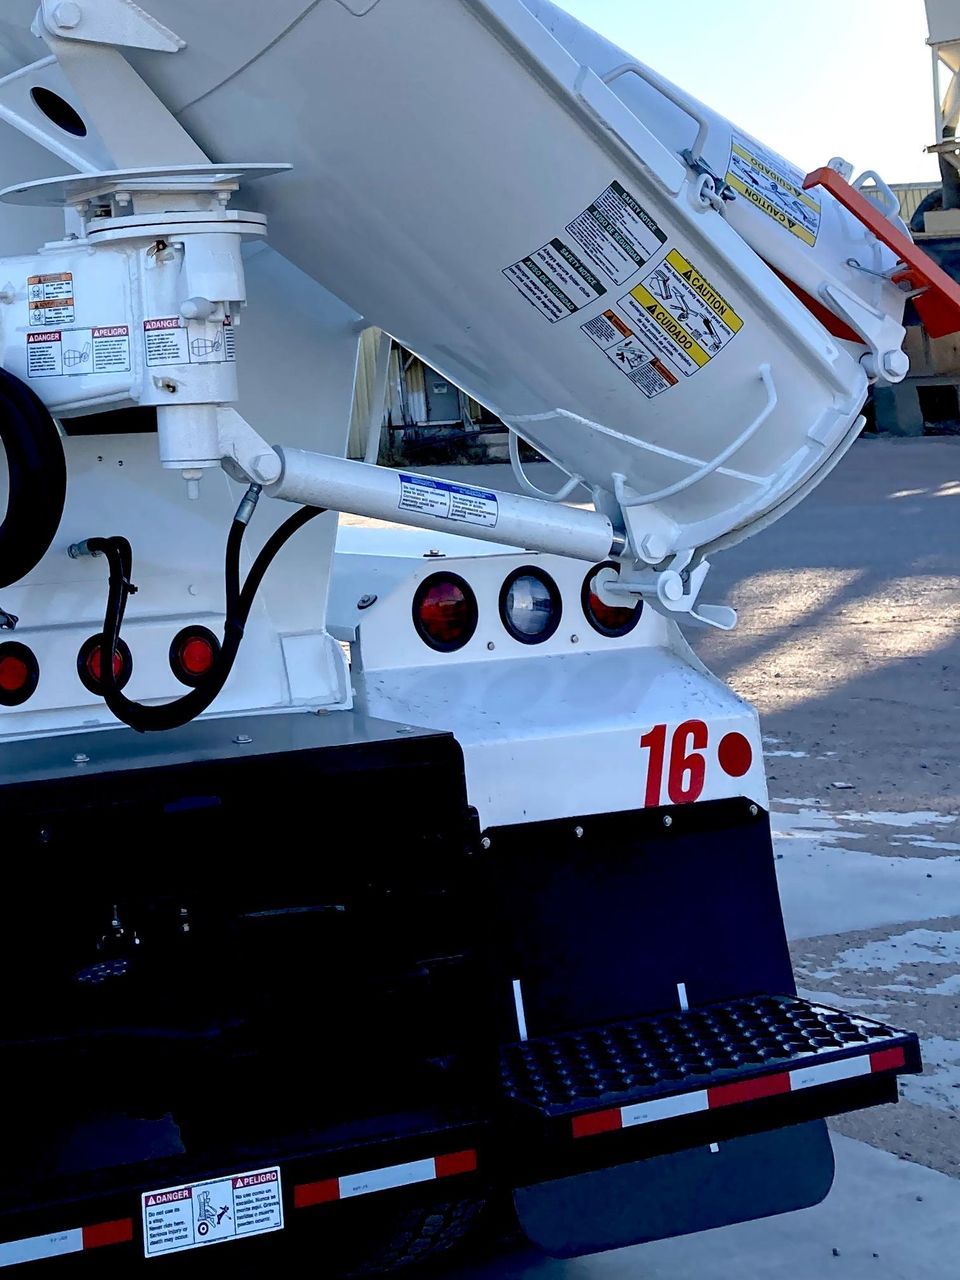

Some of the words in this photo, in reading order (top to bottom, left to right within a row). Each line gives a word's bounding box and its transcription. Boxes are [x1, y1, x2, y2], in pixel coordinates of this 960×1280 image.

[751, 158, 792, 190] CUIDADO
[620, 191, 641, 213] SAFETY
[637, 211, 658, 232] NOTICE
[744, 188, 786, 222] CAUTION
[591, 209, 608, 226] AVISO
[605, 224, 615, 233] DE
[611, 231, 641, 262] SEGURIDAD
[536, 251, 546, 261] with
[544, 259, 558, 273] safety
[541, 247, 557, 263] Always
[554, 261, 569, 276] secure
[578, 285, 591, 298] chute
[559, 246, 580, 268] SAFETY
[577, 265, 597, 286] NOTICE
[524, 259, 541, 276] AVISO
[539, 274, 547, 282] DE
[546, 281, 575, 310] SEGURIDAD
[661, 262, 672, 273] Keep
[670, 271, 682, 284] hands
[680, 282, 689, 290] and
[686, 288, 697, 300] body
[694, 297, 705, 308] away
[703, 306, 713, 316] from
[689, 276, 727, 316] CAUTION
[34, 333, 59, 341] DANGER
[99, 327, 127, 336] PELIGRO
[151, 320, 178, 328] DANGE
[654, 310, 693, 351] CUIDADO
[639, 719, 708, 808] 16
[156, 1190, 189, 1204] DANGER
[244, 1172, 275, 1186] PELIGRO
[148, 1230, 167, 1238] Serious
[167, 1227, 182, 1236] injury
